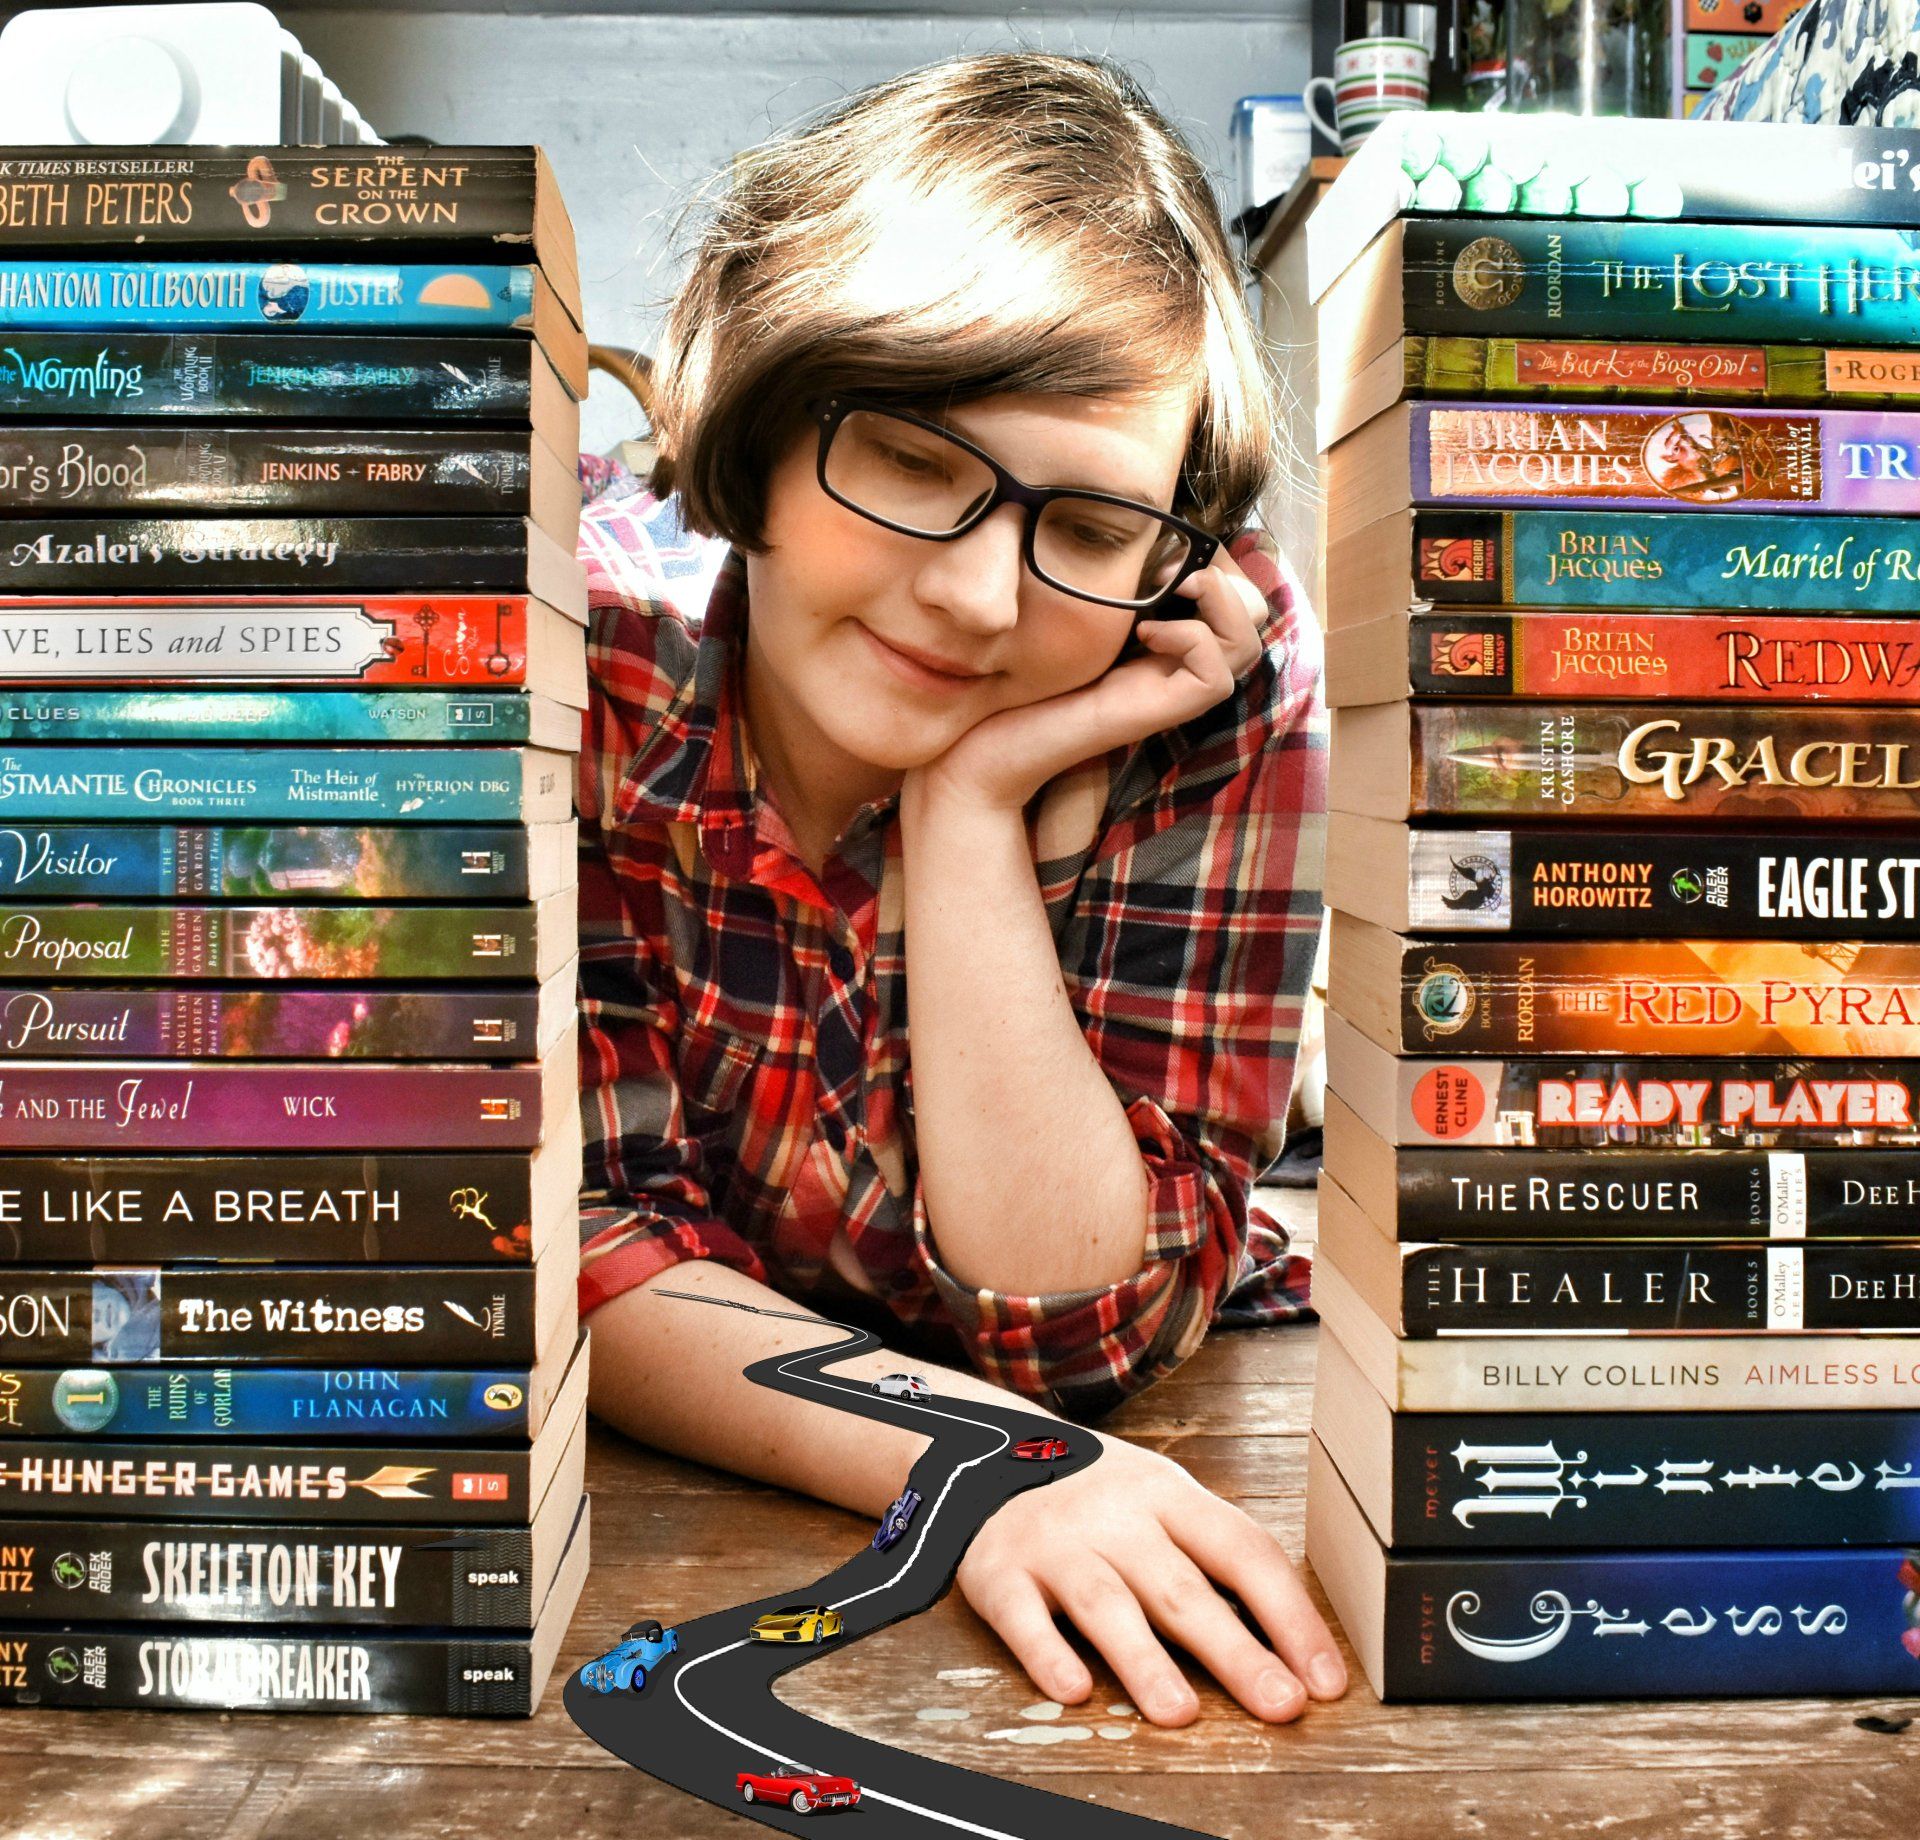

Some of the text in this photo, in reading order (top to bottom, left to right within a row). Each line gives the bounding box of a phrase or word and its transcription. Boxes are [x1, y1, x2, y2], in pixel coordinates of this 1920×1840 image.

[18, 161, 194, 175] TIMES BESTSELLER!
[311, 167, 469, 187] SERPENT
[376, 156, 404, 166] THE
[85, 182, 193, 225] PETERS
[315, 202, 457, 225] CROWN
[358, 190, 418, 200] ON THE
[110, 272, 246, 308] TOLLBOOTH
[317, 273, 404, 310] JUSTER
[1436, 240, 1445, 304] BOOK ONE
[1547, 234, 1562, 318] RIORDAN
[4, 347, 144, 399] Wormling
[198, 365, 210, 393] BOOK
[1698, 353, 1748, 375] Owl
[1467, 419, 1608, 451] BRIAN
[1786, 423, 1799, 480] TALE of
[57, 444, 147, 499] Blood
[261, 463, 427, 484] JENKINS FABRY
[1444, 453, 1633, 490] JACQUES
[1801, 423, 1813, 496] REDWALL
[10, 530, 340, 568] Azalei's Strategy
[1473, 539, 1484, 581] FIREBIRD
[1485, 539, 1495, 581] FANTASY
[1721, 537, 1882, 591] Mariel of
[76, 627, 154, 654] LIES
[168, 626, 226, 654] and
[240, 627, 342, 654] SPIES
[1484, 633, 1494, 676] FIREBIRD
[1496, 634, 1506, 676] FANTASY
[8, 707, 81, 721] CLUES
[368, 708, 427, 721] WATSON
[2, 758, 22, 771] The
[291, 769, 380, 787] The Heir of
[1541, 720, 1555, 799] KRISTIN
[1561, 715, 1575, 805] CASHORE
[172, 797, 246, 806] BOOK THREE
[288, 785, 379, 801] Mistmantle
[396, 779, 511, 794] HYPERION DBG
[0, 830, 118, 884] Visitor
[163, 847, 173, 875] THE
[179, 830, 189, 893] ENGLISH
[195, 833, 204, 889] GARDEN
[1533, 862, 1653, 884] ANTHONY
[1533, 886, 1653, 908] HOROWITZ
[1706, 867, 1718, 905] ALEX
[1717, 866, 1729, 907] RIDER
[1759, 857, 1868, 918] EAGLE
[2, 914, 133, 971] Proposal
[161, 929, 170, 956] THE
[177, 912, 186, 974] ENGLISH
[193, 915, 202, 972] GARDEN
[1481, 998, 1492, 1029] BOOK
[1518, 957, 1535, 1042] RIORDAN
[1555, 991, 1610, 1012] THE
[1619, 981, 1742, 1025] RED
[5, 993, 130, 1050] Pursuit
[161, 1011, 171, 1040] THE
[177, 994, 187, 1055] ENGLISH
[193, 996, 202, 1055] GARDEN
[16, 1079, 193, 1127] AND THE Jewel
[283, 1096, 337, 1117] WICK
[1436, 1070, 1449, 1135] ERNEST
[1455, 1078, 1468, 1127] CLINE
[1537, 1079, 1914, 1127] READY PLAYER
[43, 1190, 399, 1222] LIKE A BREATH
[1750, 1168, 1761, 1225] BOOK 6
[1776, 1169, 1792, 1225] O'Malley
[1795, 1168, 1803, 1225] SERIES
[1428, 1264, 1440, 1309] THE
[1452, 1267, 1716, 1303] HEALER
[1747, 1272, 1758, 1318] BOOK
[1774, 1261, 1790, 1317] O'Malley
[1792, 1260, 1801, 1317] SERIES
[178, 1298, 424, 1333] The Witness
[492, 1293, 506, 1338] TYNDALE
[323, 1371, 400, 1393] JOHN
[1483, 1365, 1719, 1386] BILLY COLLINS
[1745, 1364, 1878, 1385] AIMLESS
[148, 1386, 162, 1409] THE
[169, 1373, 191, 1420] RUINS
[194, 1389, 208, 1405] OF
[213, 1369, 235, 1427] GORLAN
[293, 1399, 448, 1418] FLANAGAN
[21, 1458, 346, 1498] HUNGER GAMES
[89, 1552, 101, 1591] ALEX
[100, 1551, 112, 1594] RIDER
[142, 1541, 402, 1608] SKELETON KEY
[468, 1570, 519, 1586] speak
[1446, 1590, 1848, 1664] Cress
[83, 1647, 96, 1687] ALEX
[95, 1646, 107, 1689] RIDER
[463, 1667, 514, 1683] speak
